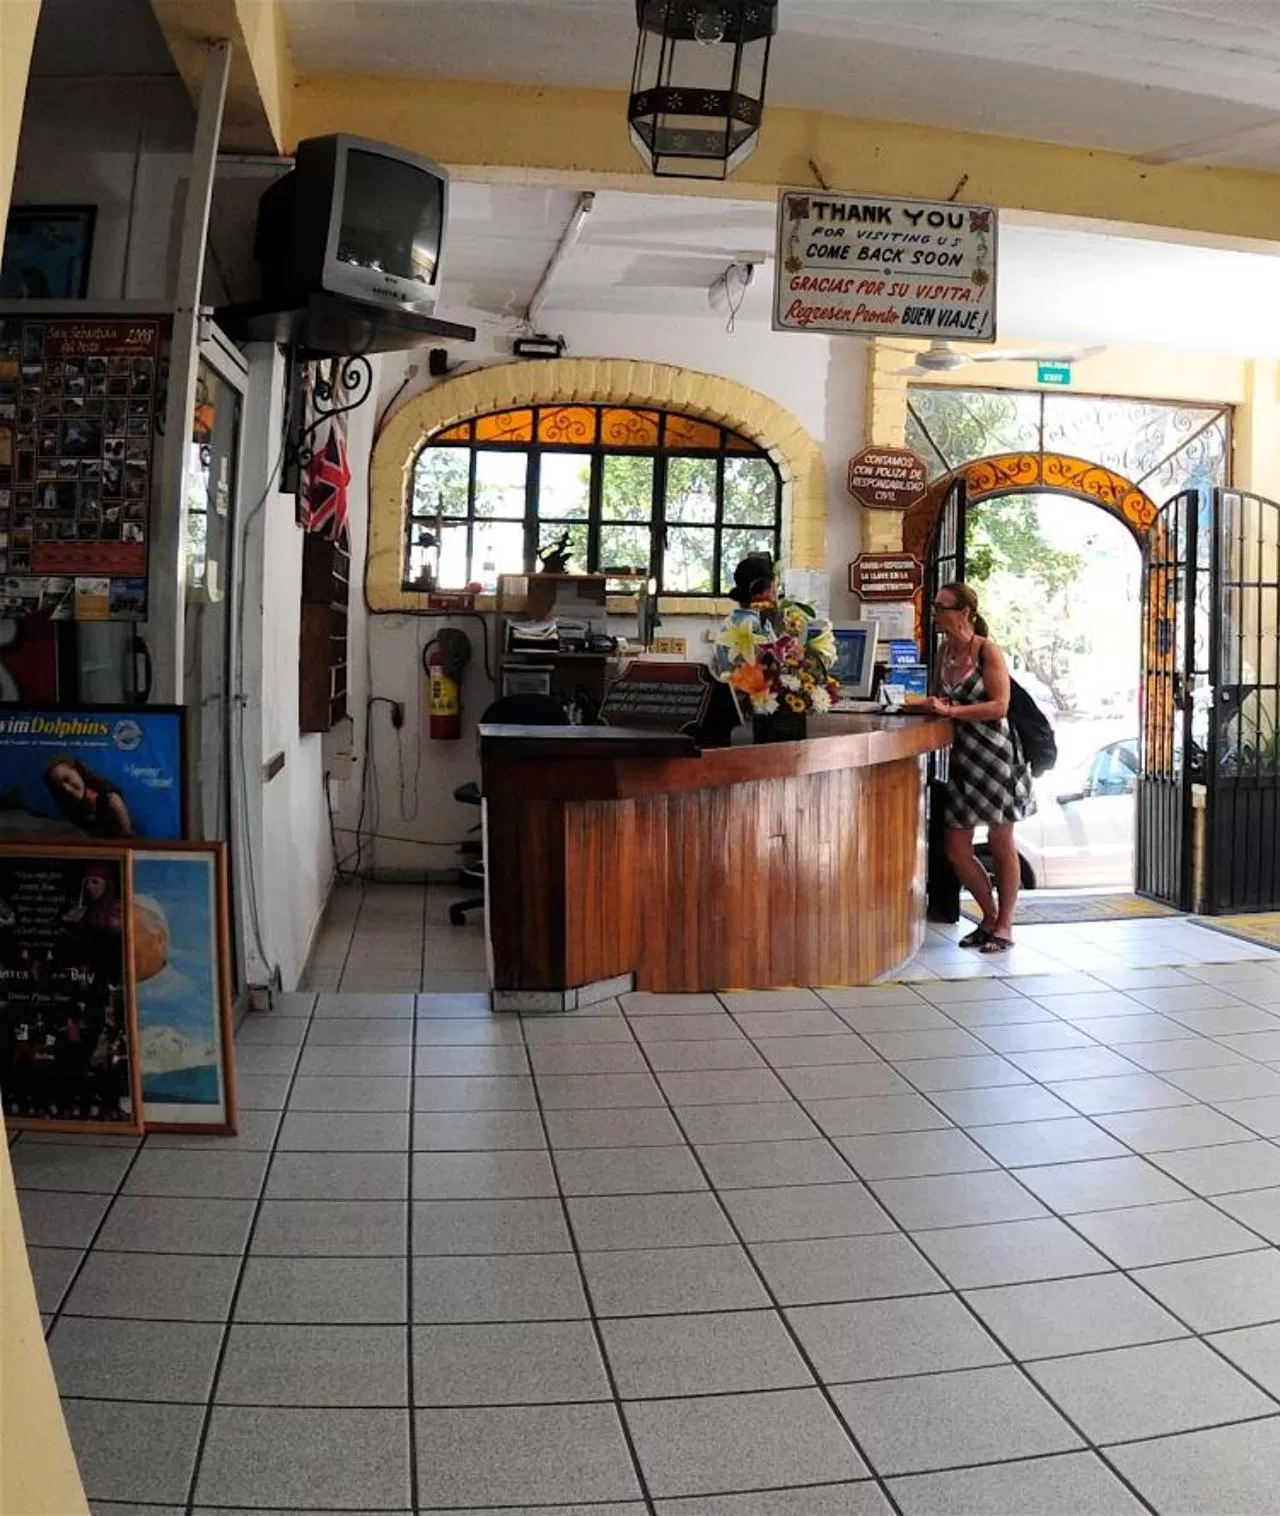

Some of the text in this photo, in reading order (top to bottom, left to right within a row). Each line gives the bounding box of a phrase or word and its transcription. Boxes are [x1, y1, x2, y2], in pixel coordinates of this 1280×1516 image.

[812, 202, 964, 230] THANK YOU
[811, 227, 962, 248] FOR VISITING US
[806, 244, 964, 267] COME BACK SOON
[789, 275, 854, 295] GRACIAS
[856, 279, 883, 296] POR
[887, 282, 911, 298] SU
[852, 303, 900, 326] Pronto
[902, 305, 936, 328] BUEN
[937, 308, 989, 334] VIAJE!
[854, 465, 873, 476] CON
[909, 470, 923, 480] DE
[864, 455, 914, 468] CONTAMOS
